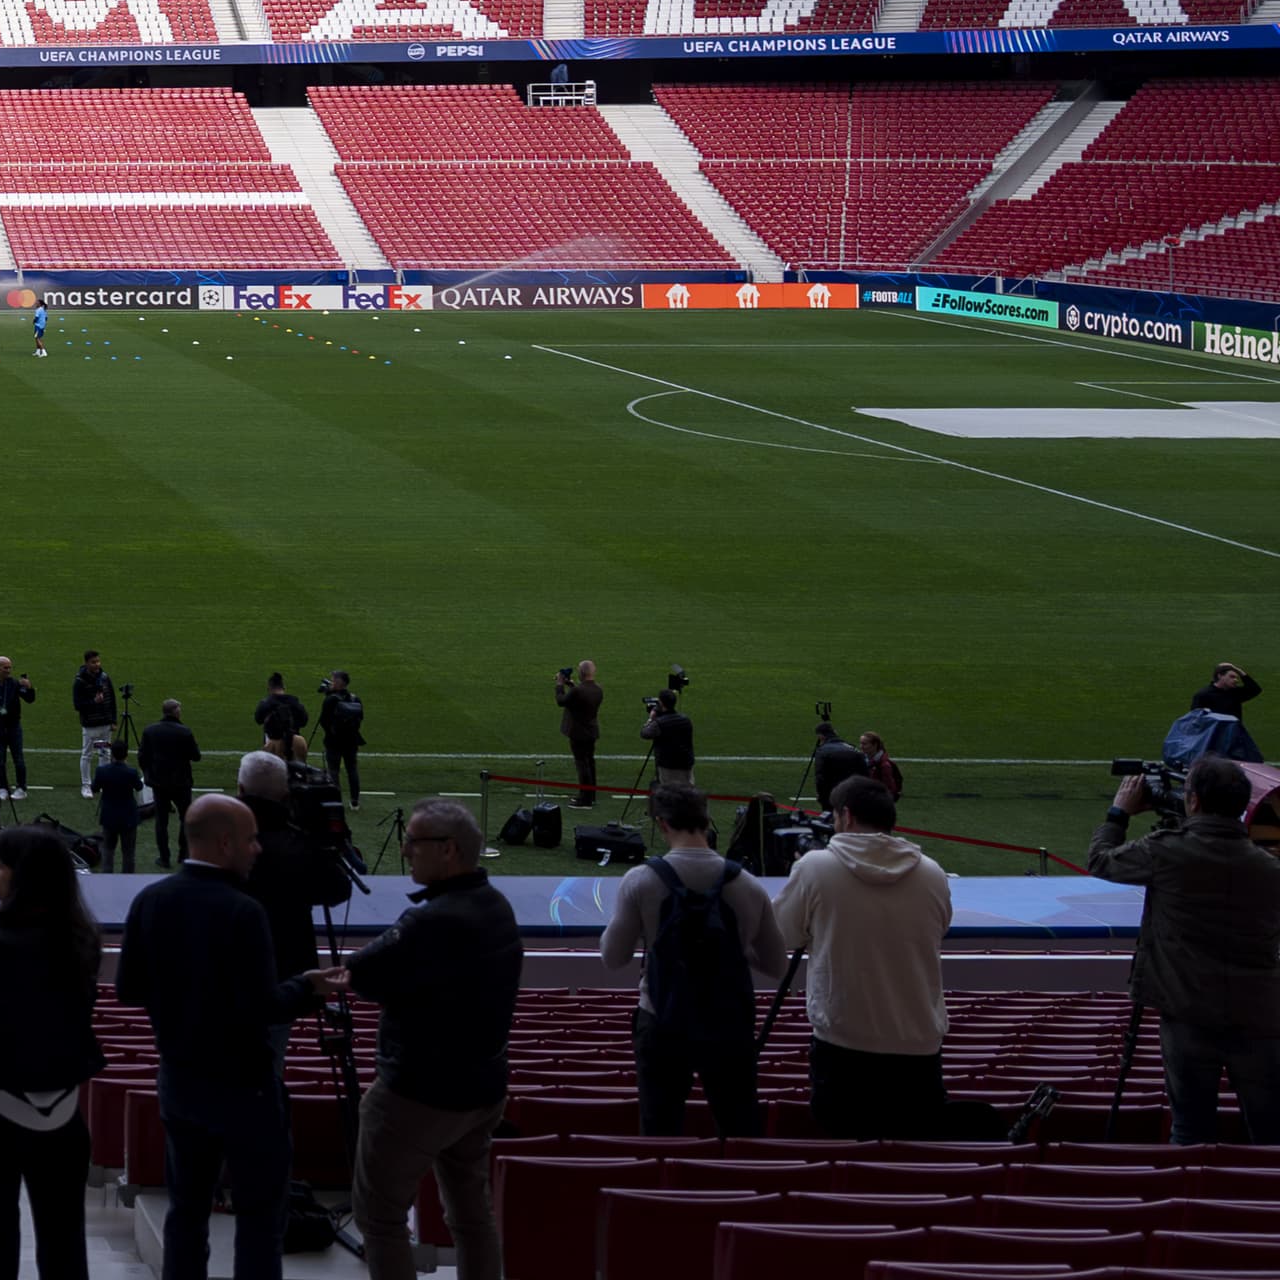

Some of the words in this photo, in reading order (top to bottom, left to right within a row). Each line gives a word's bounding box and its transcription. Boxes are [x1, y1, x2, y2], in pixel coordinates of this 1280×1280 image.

[683, 38, 724, 54] UEFA
[728, 37, 828, 53] CHAMPIONS
[831, 36, 897, 52] LEAGUE
[1112, 31, 1162, 46] QATAR
[1165, 29, 1231, 44] AIRWAYS
[39, 50, 76, 63] UEFA
[78, 48, 165, 62] CHAMPIONS
[167, 48, 221, 61] LEAGUE
[436, 44, 484, 57] PEPSI
[43, 286, 192, 307] mastercard
[233, 285, 313, 310] FedEx
[343, 285, 422, 310] FedEx
[440, 287, 523, 310] QATAR
[532, 286, 635, 306] AIRWAYS
[862, 290, 913, 305] #FOOTBALL
[933, 292, 1049, 322] FollowScores.com
[1084, 307, 1182, 344] crypto.com
